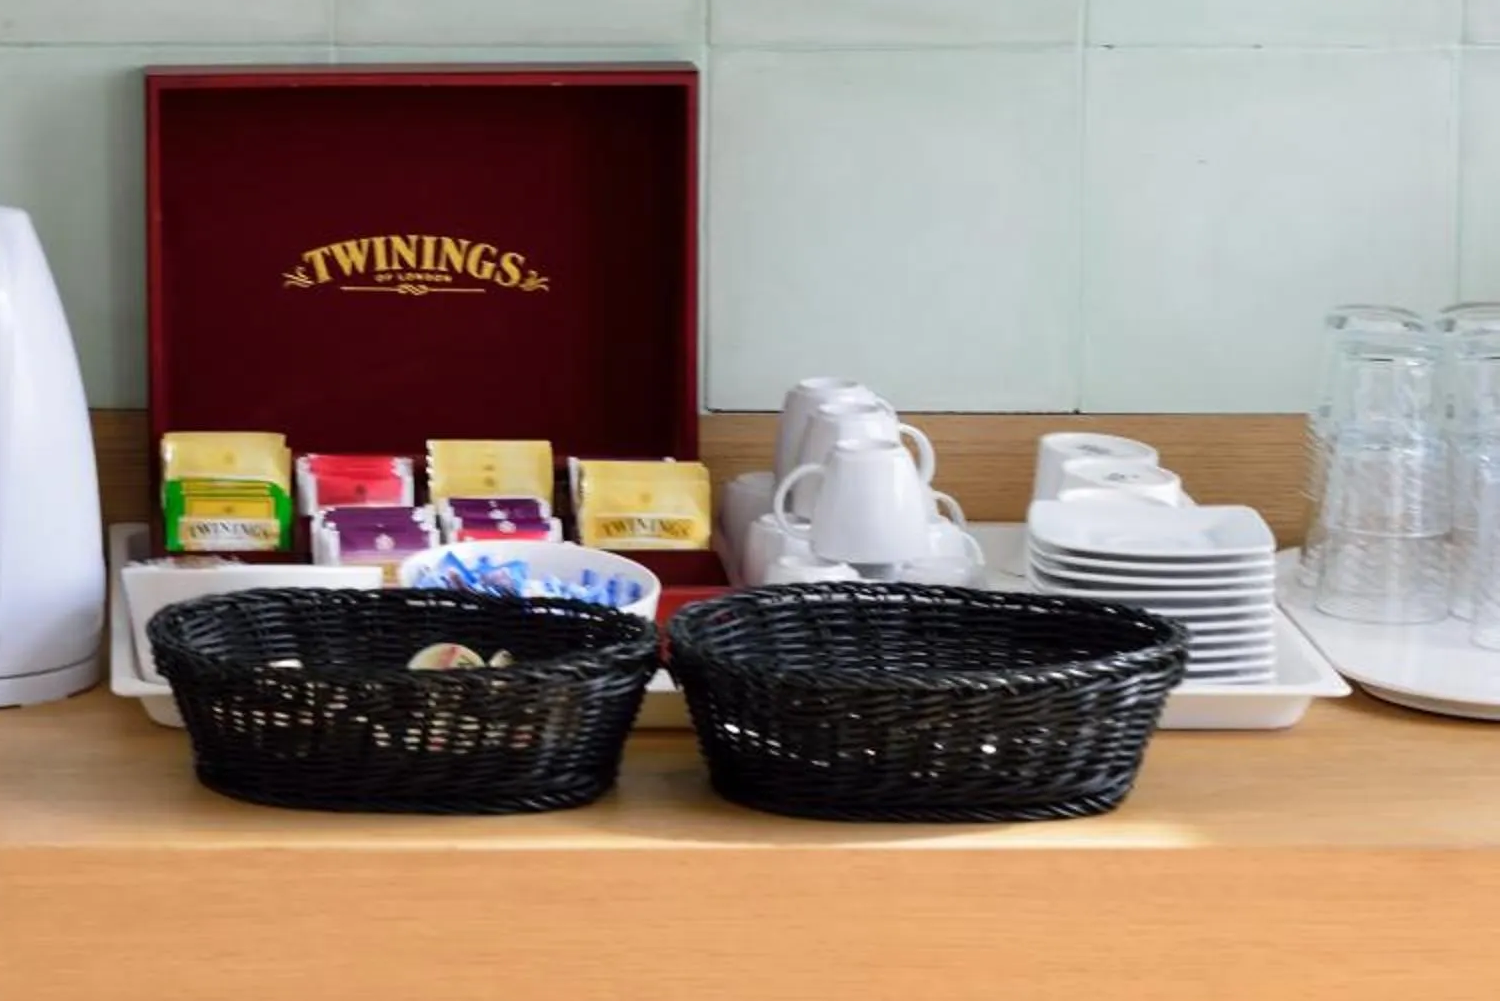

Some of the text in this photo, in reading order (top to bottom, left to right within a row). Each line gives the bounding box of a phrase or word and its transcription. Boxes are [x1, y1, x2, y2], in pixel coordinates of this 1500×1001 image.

[302, 234, 526, 287] TWININGS
[374, 272, 453, 283] OF LONDON
